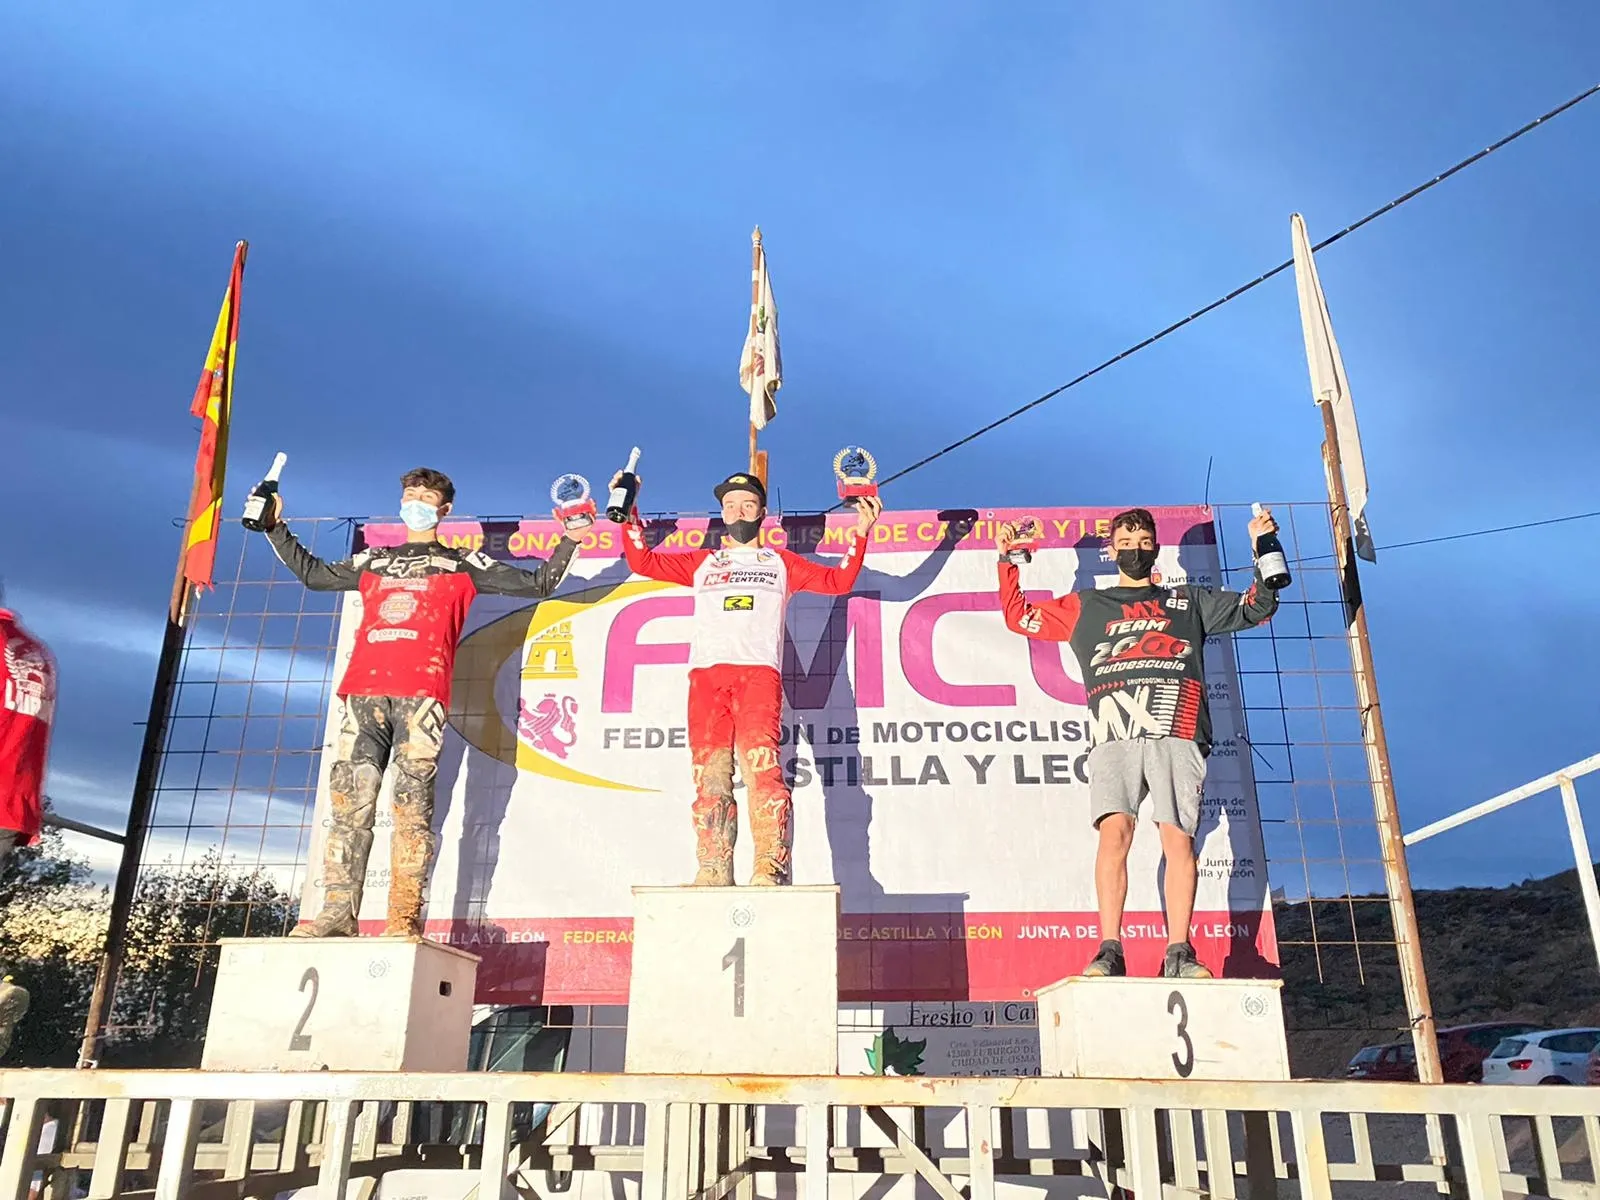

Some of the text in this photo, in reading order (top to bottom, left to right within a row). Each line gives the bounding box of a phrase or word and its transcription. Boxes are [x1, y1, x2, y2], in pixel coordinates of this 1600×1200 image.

[874, 523, 908, 543] DE
[1053, 520, 1071, 539] Y
[731, 571, 777, 579] MOTOCROSS
[1167, 575, 1212, 584] Junta de
[1121, 600, 1166, 620] MX
[1108, 619, 1168, 637] TEAM
[1095, 659, 1186, 677] autoescuela
[1215, 682, 1228, 690] de
[1088, 685, 1157, 746] MX
[827, 727, 860, 745] DE
[873, 720, 1090, 744] MOTOCICLIS
[1223, 739, 1237, 747] de
[964, 754, 996, 785] Y
[1231, 797, 1245, 806] de
[1219, 807, 1246, 816] León
[1204, 857, 1255, 867] Junta de
[1217, 870, 1223, 880] y
[1227, 868, 1255, 878] León
[428, 931, 480, 945] STILLA
[486, 931, 496, 944] Y
[504, 929, 545, 944] LEÓN
[858, 926, 936, 940] CASTILLA
[943, 926, 952, 939] Y
[959, 924, 1003, 939] LEÓN
[1017, 926, 1070, 939] JUNTA
[1076, 926, 1098, 939] DE
[1189, 925, 1199, 937] Y
[1204, 921, 1249, 937] LEÓN
[722, 937, 745, 1017] 1
[287, 967, 319, 1051] 2
[908, 1006, 973, 1026] Fresno
[1167, 990, 1194, 1078] 3
[987, 1046, 1020, 1057] BURGO
[951, 1054, 1037, 1068] CIUDAD DE OSMA
